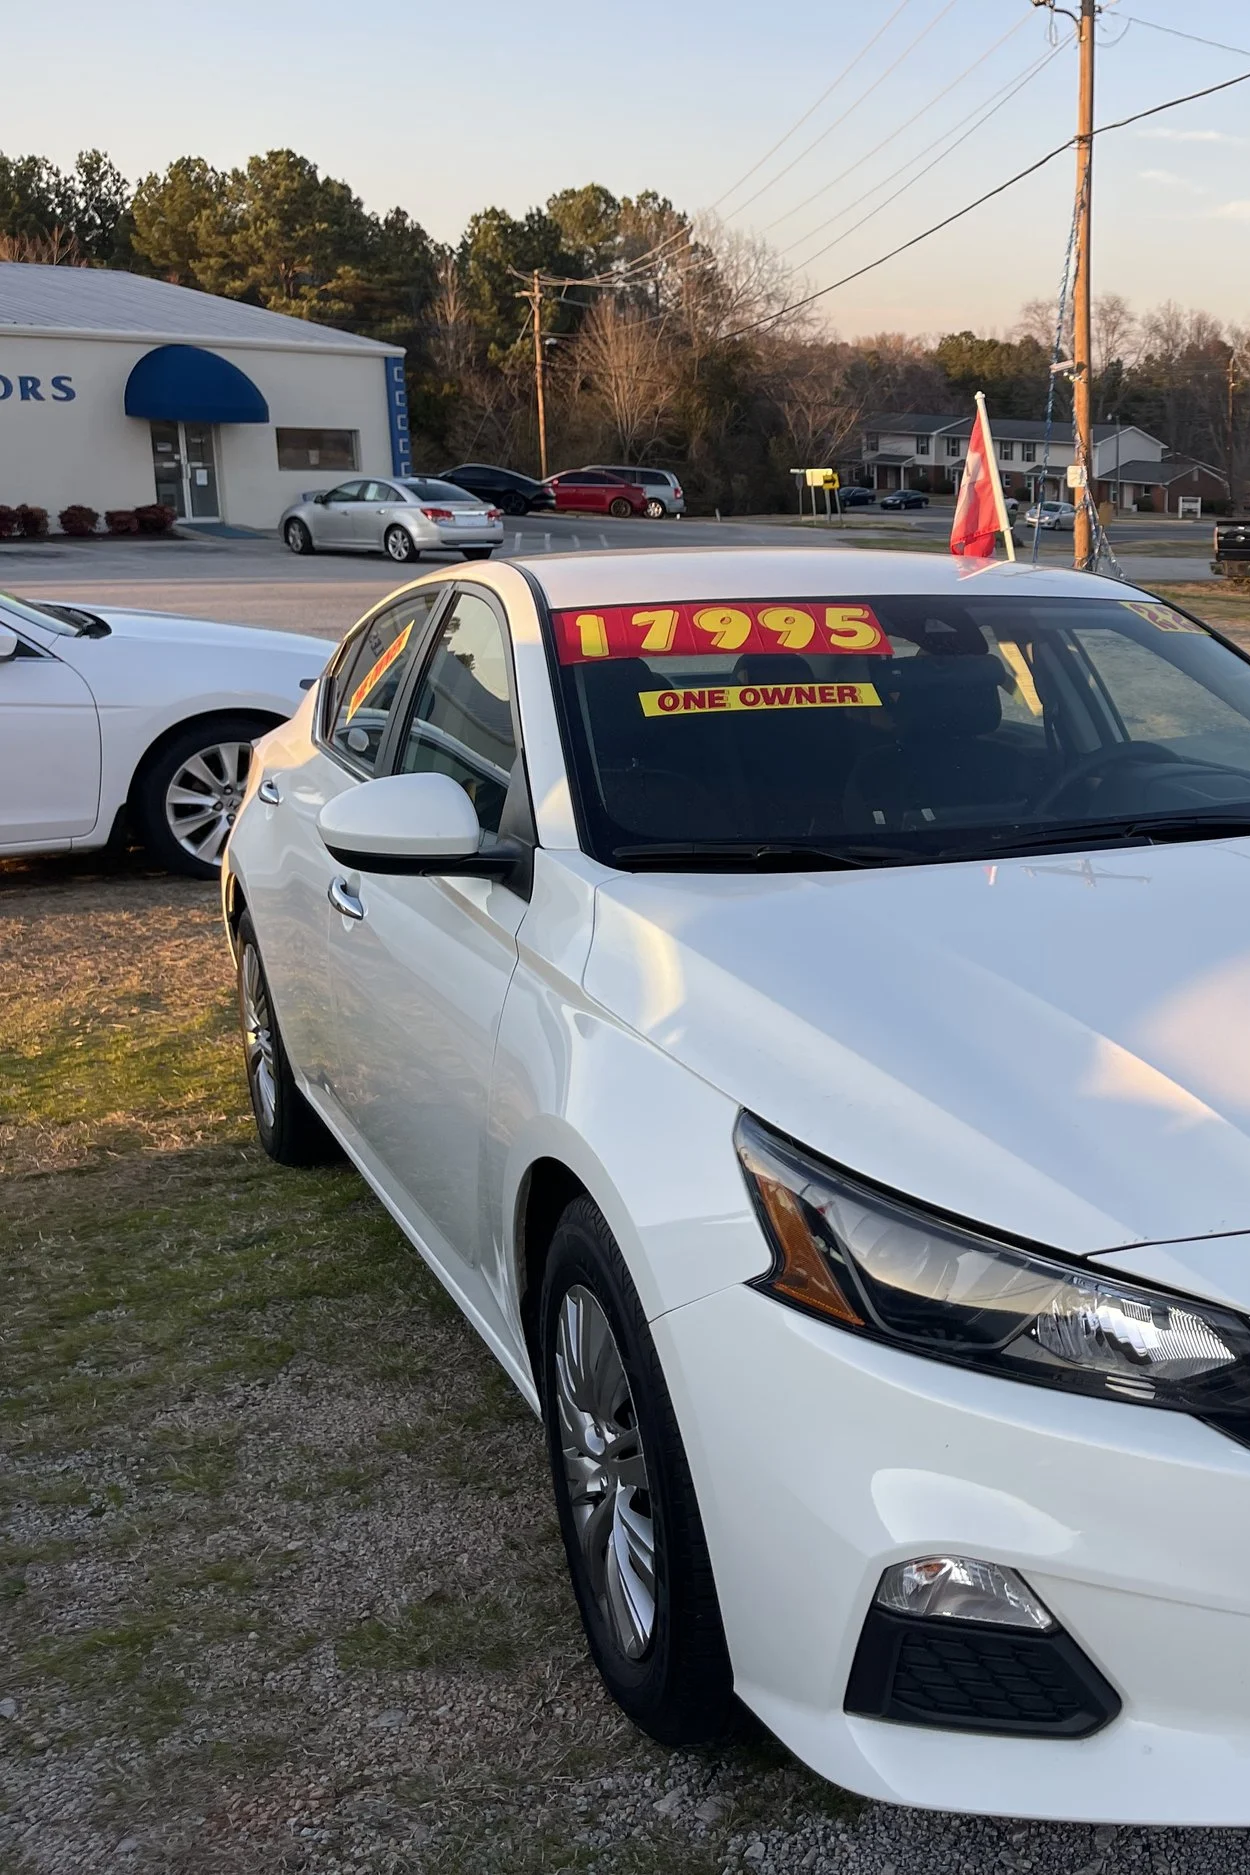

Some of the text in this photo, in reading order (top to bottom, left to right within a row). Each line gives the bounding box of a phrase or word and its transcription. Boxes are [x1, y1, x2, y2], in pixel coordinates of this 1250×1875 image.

[575, 606, 881, 657] 17995
[657, 685, 863, 712] ONE OWNER
